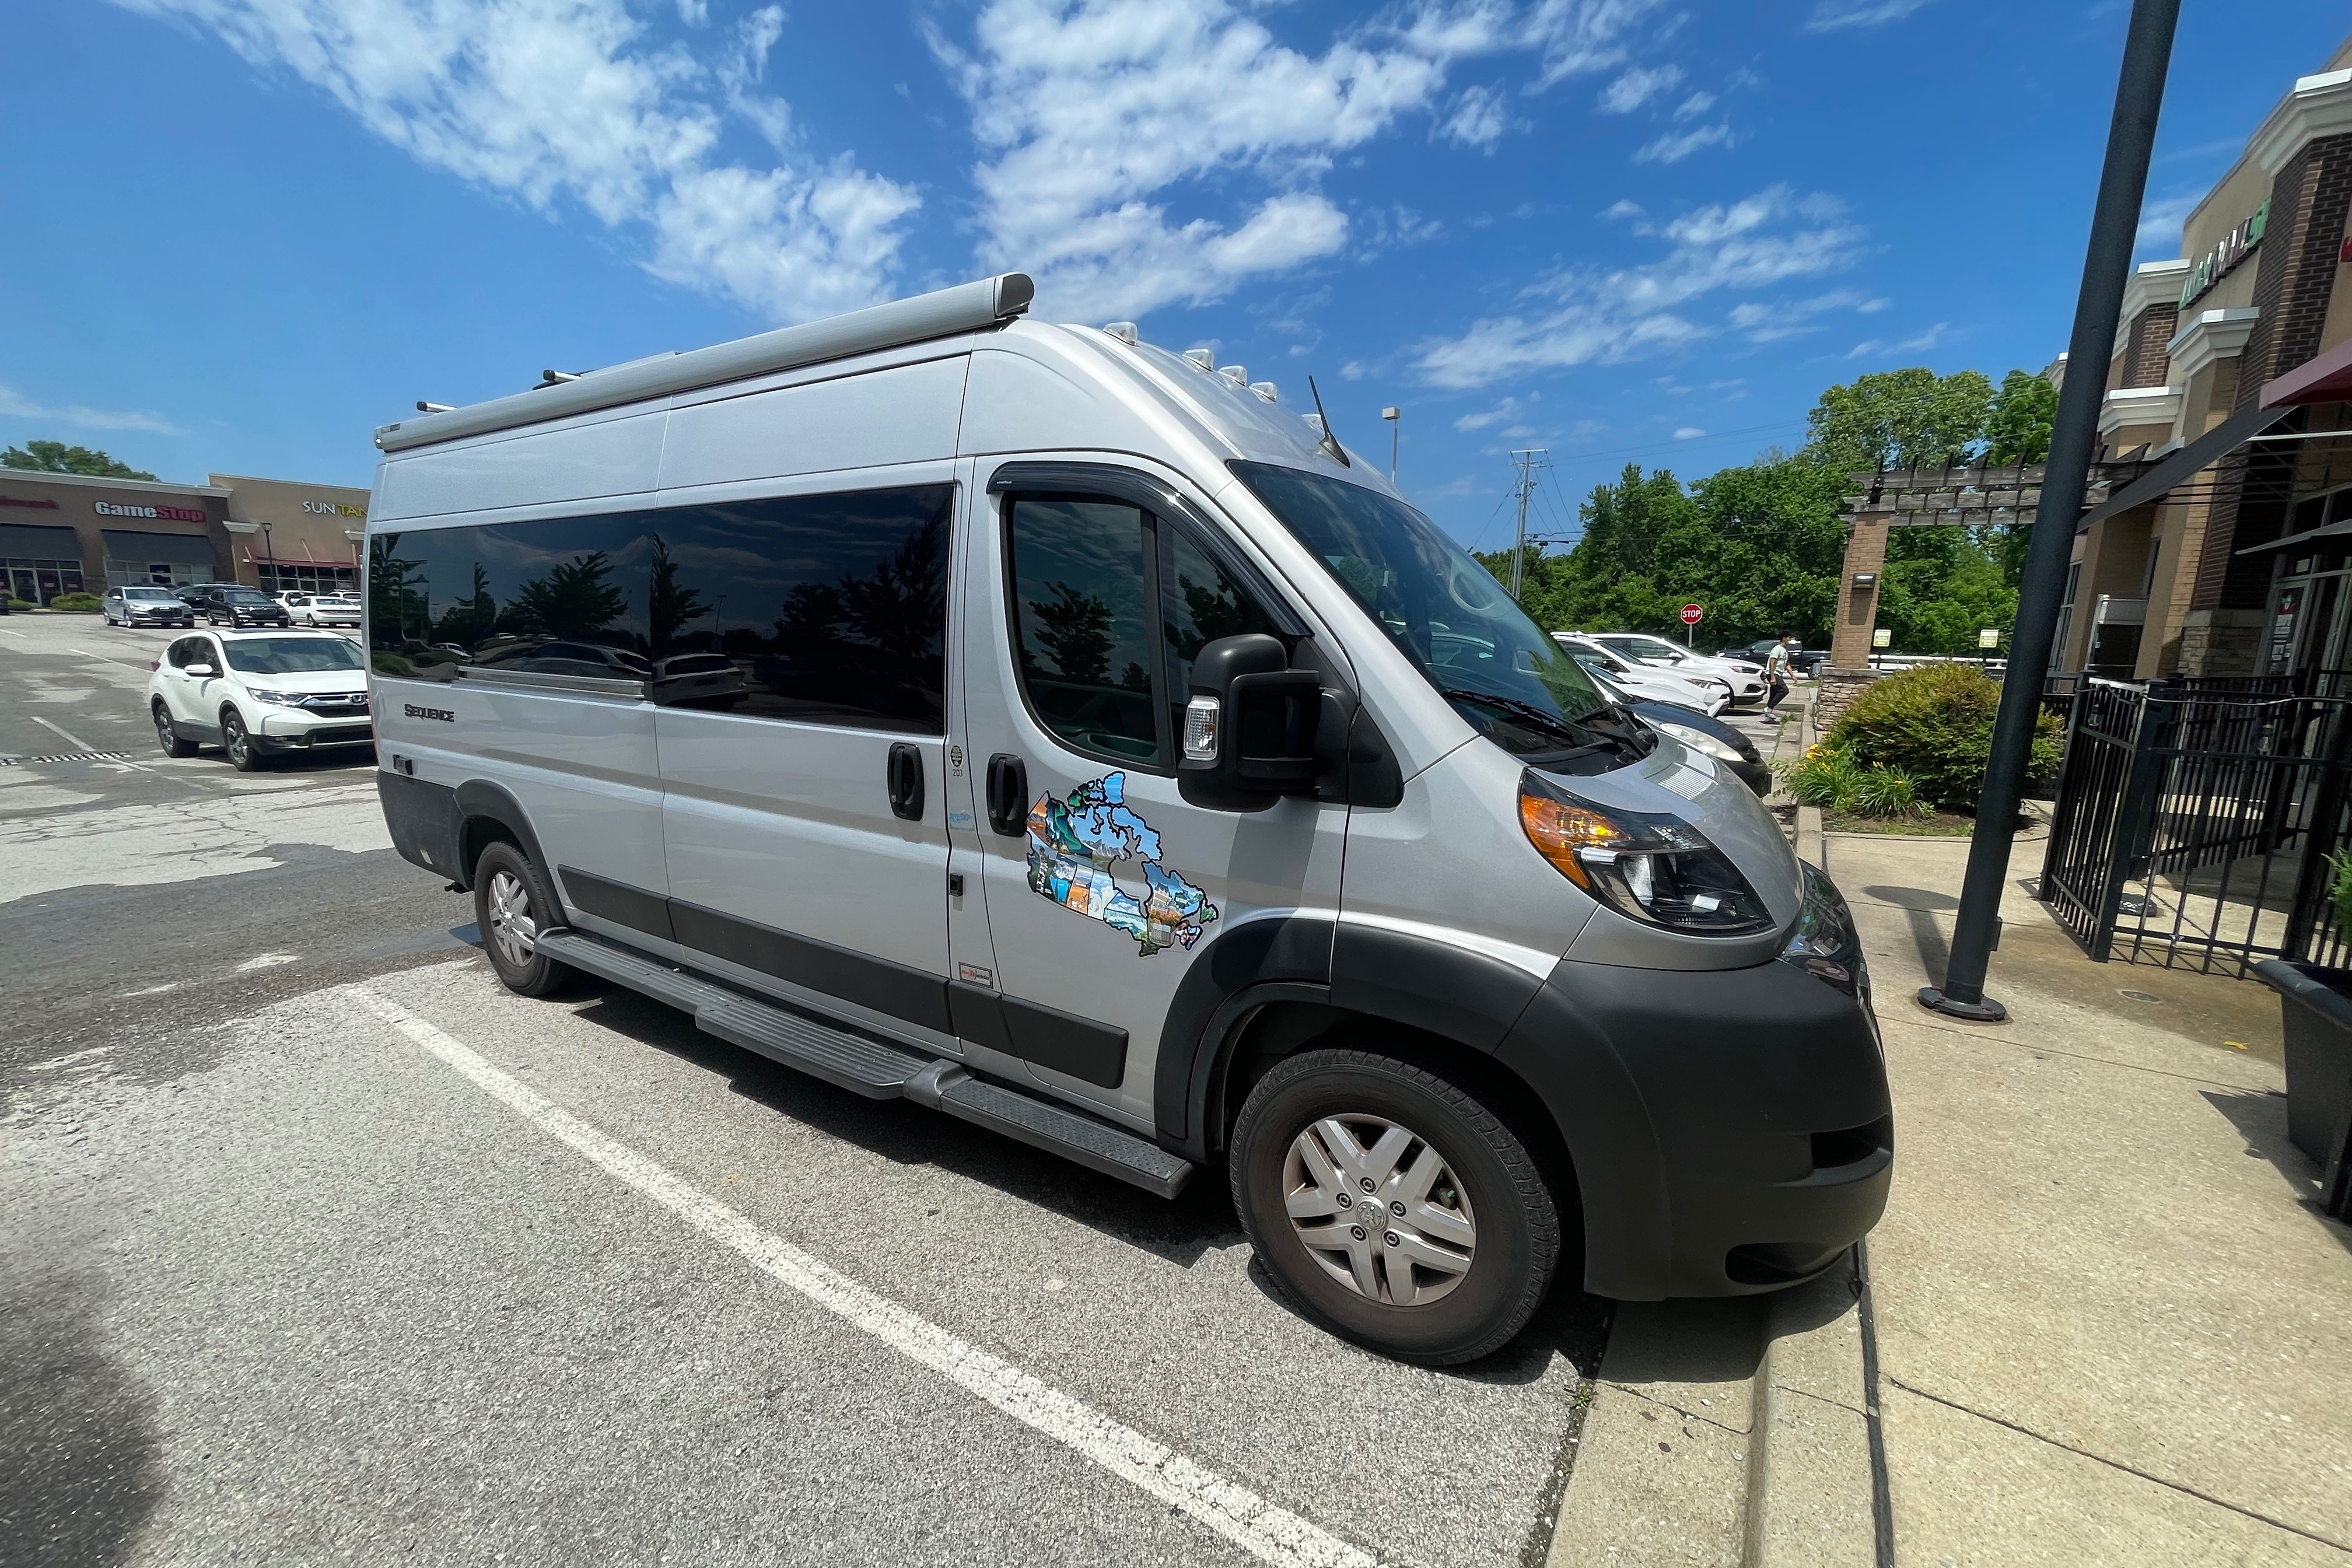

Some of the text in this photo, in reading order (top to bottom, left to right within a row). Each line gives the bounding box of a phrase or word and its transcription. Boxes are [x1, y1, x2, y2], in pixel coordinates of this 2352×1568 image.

[94, 501, 205, 523] GameStop
[303, 501, 367, 517] SUN TAN
[1682, 610, 1701, 618] STOP
